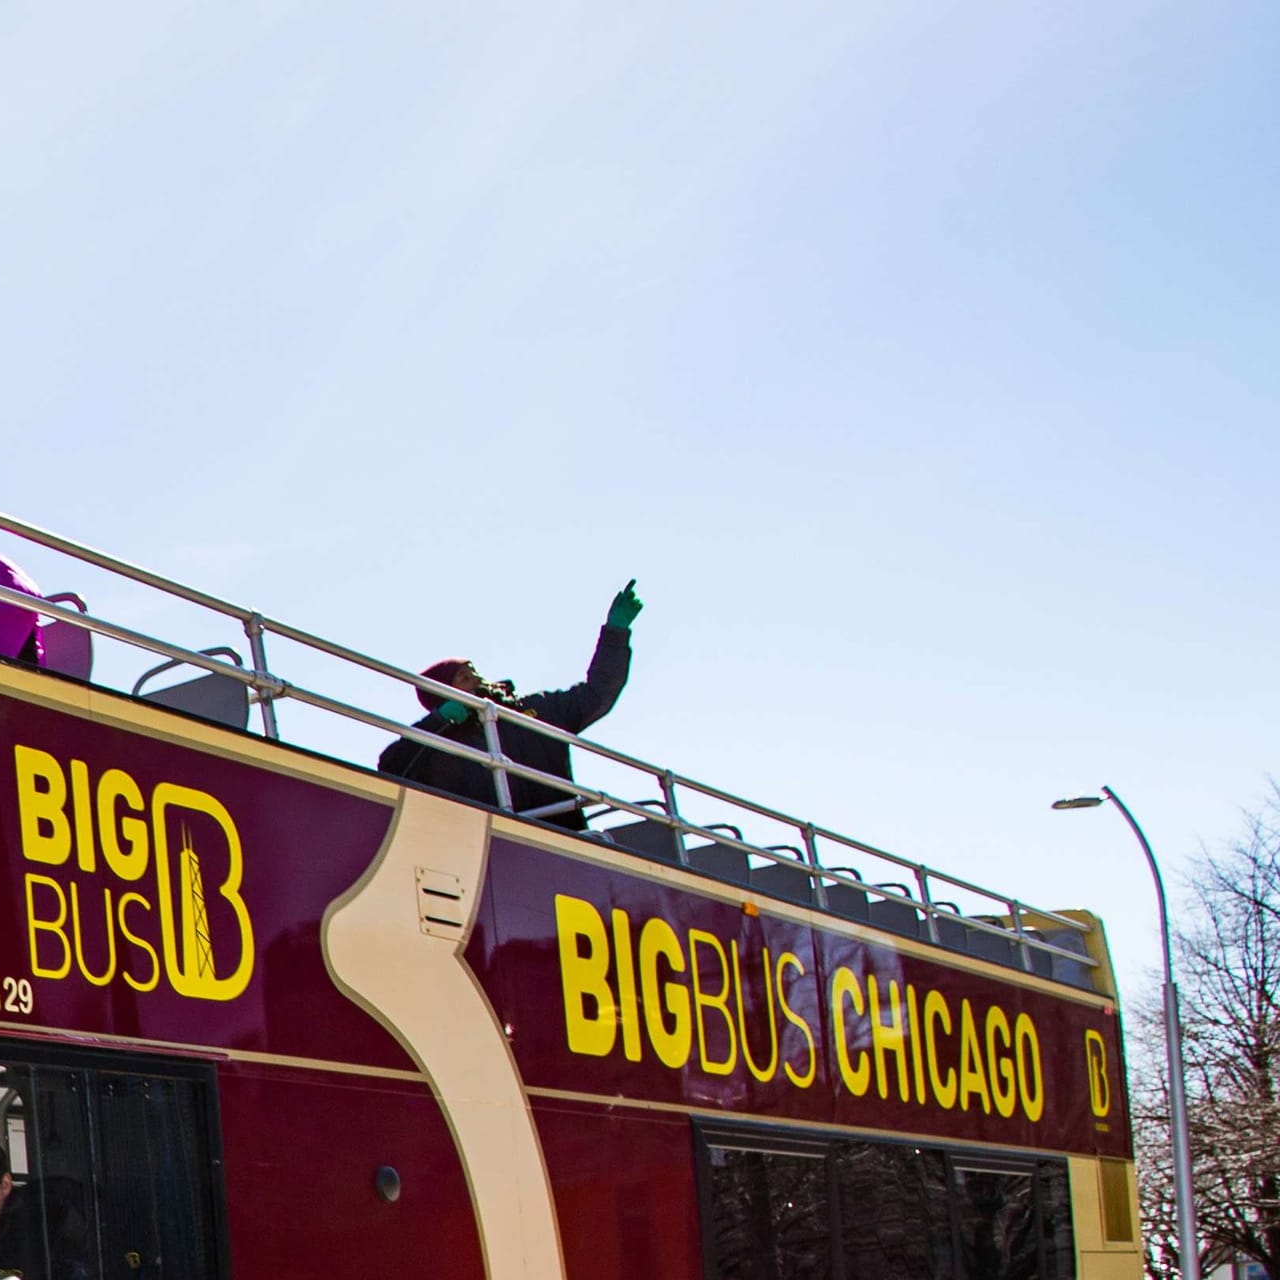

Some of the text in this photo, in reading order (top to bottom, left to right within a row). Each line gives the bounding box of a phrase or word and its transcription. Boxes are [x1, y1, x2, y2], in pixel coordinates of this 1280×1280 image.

[14, 744, 149, 882] BIG
[25, 873, 160, 992] BUS
[832, 966, 1045, 1123] CHICAGO
